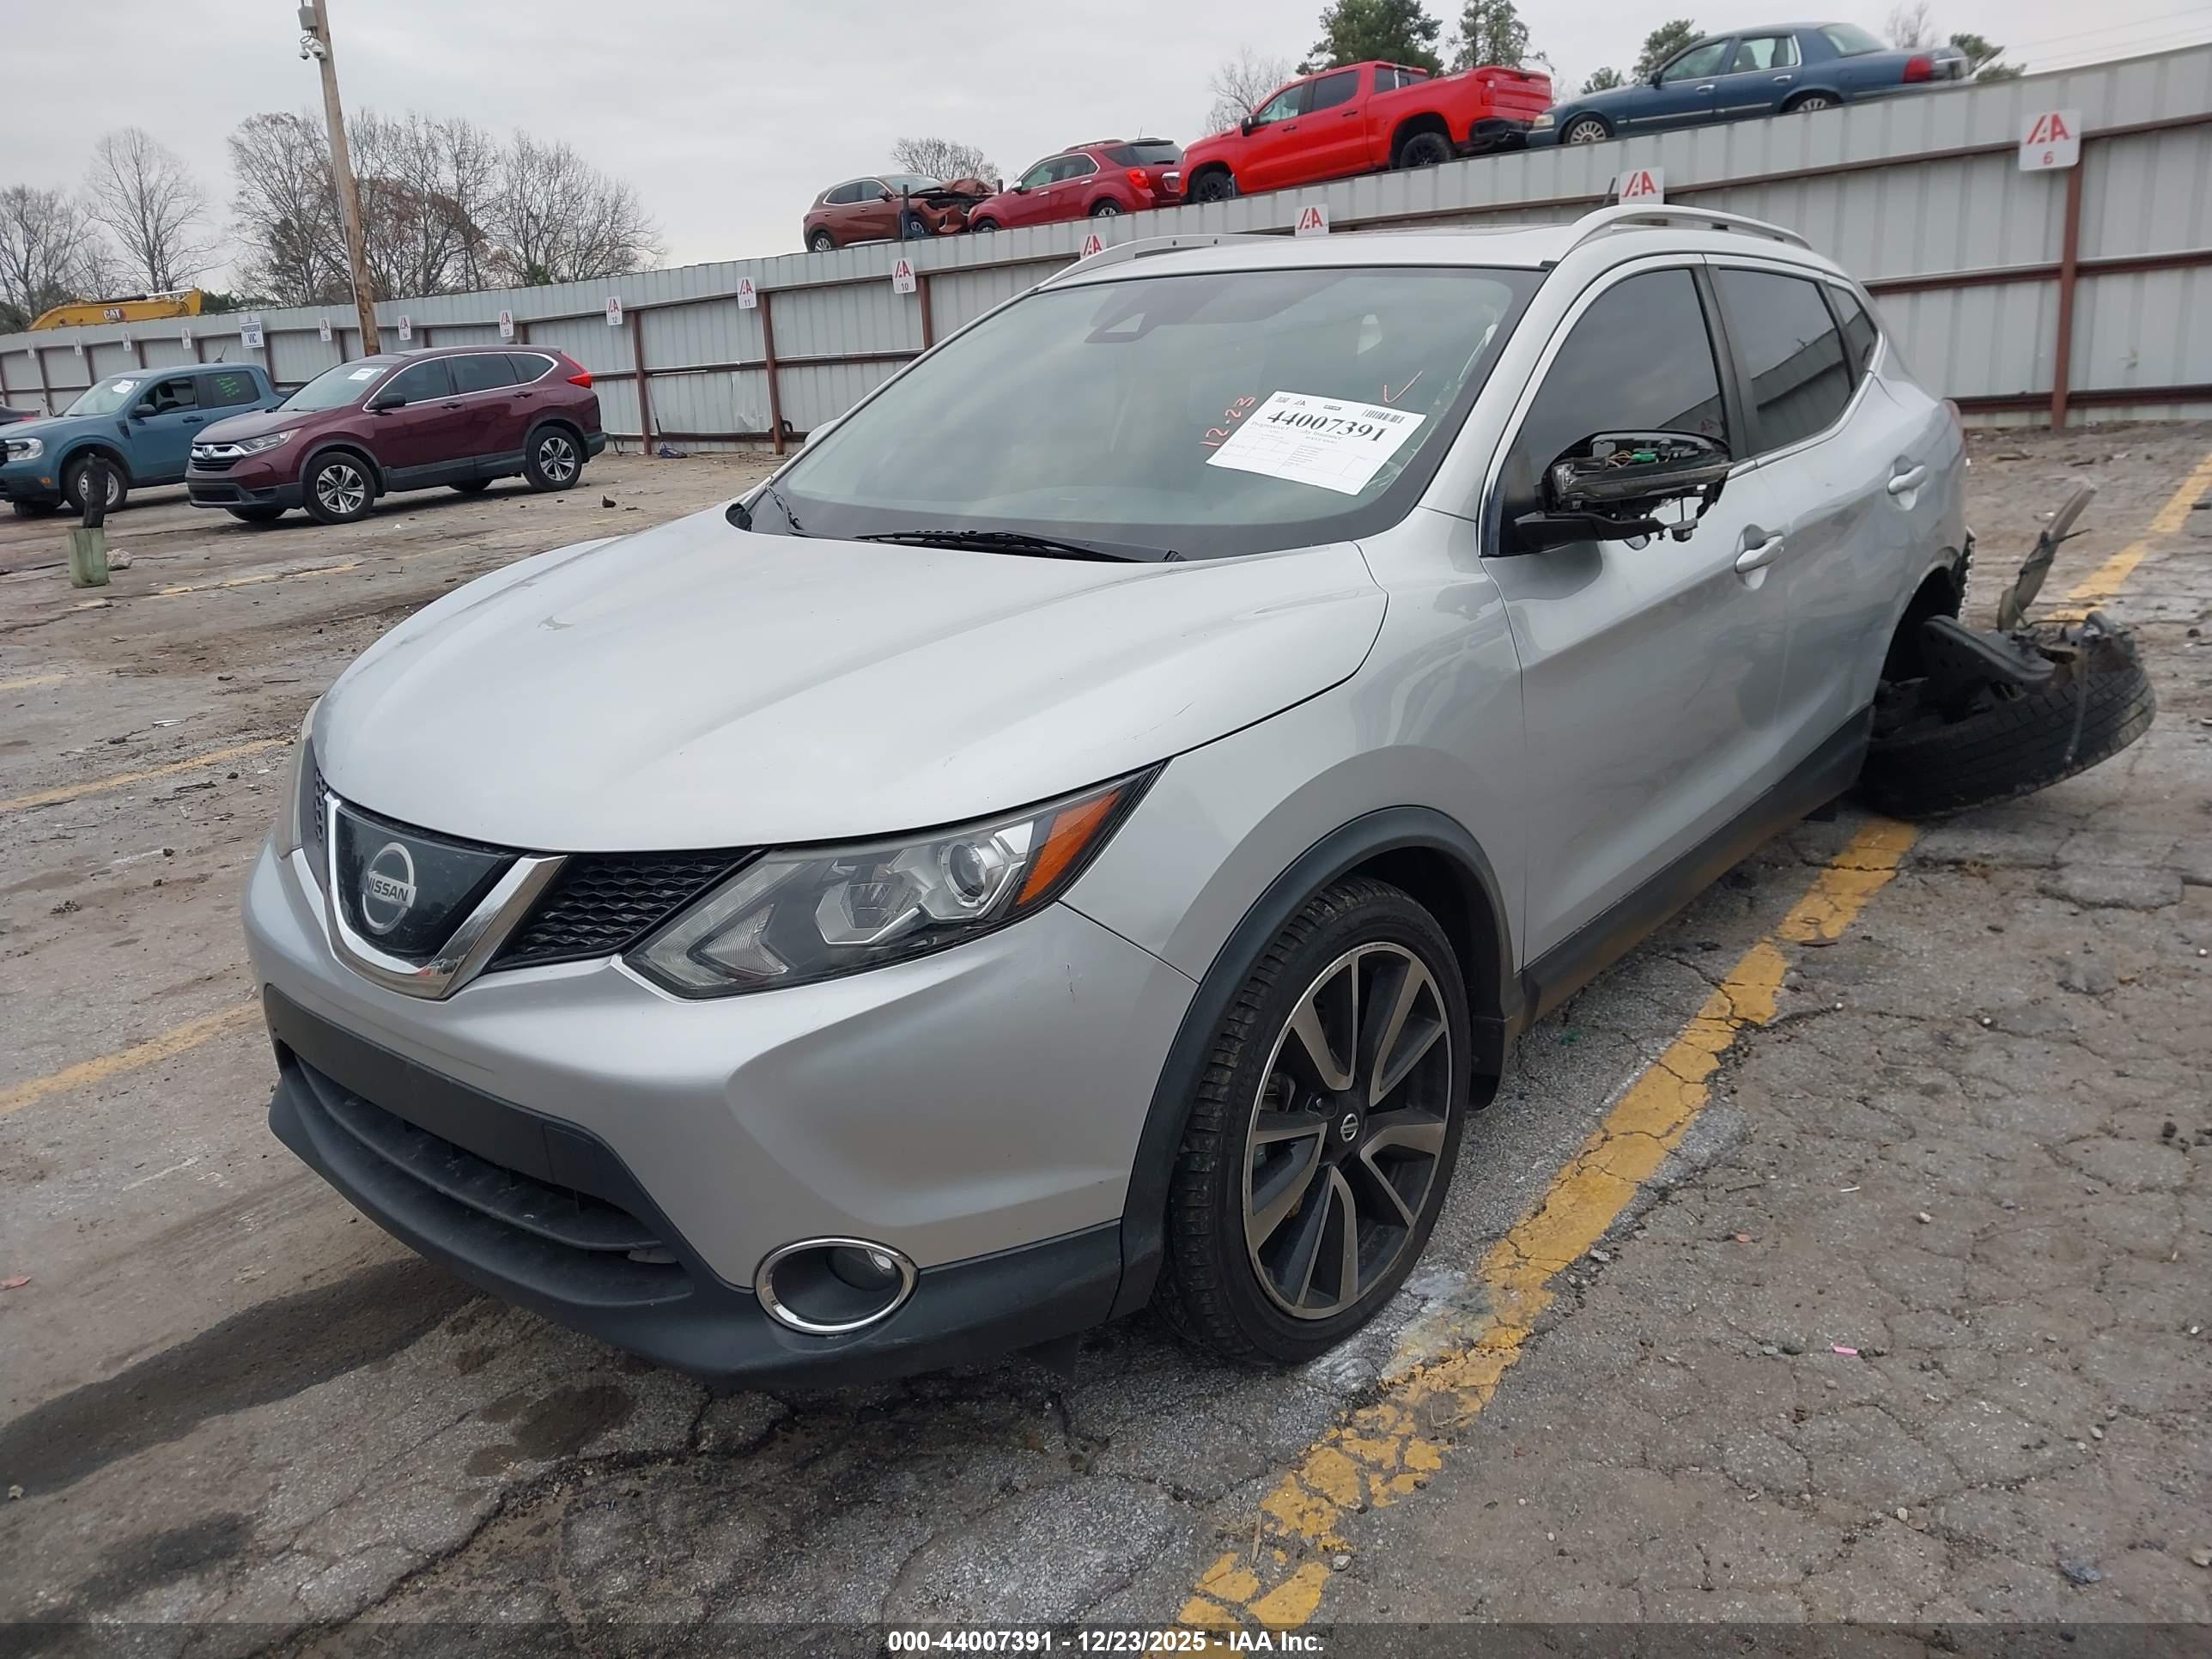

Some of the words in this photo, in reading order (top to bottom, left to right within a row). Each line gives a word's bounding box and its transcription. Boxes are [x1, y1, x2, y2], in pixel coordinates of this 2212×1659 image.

[2043, 150, 2055, 165] 6
[901, 283, 909, 292] 10
[103, 308, 120, 320] CAT
[1267, 410, 1388, 441] 44007391
